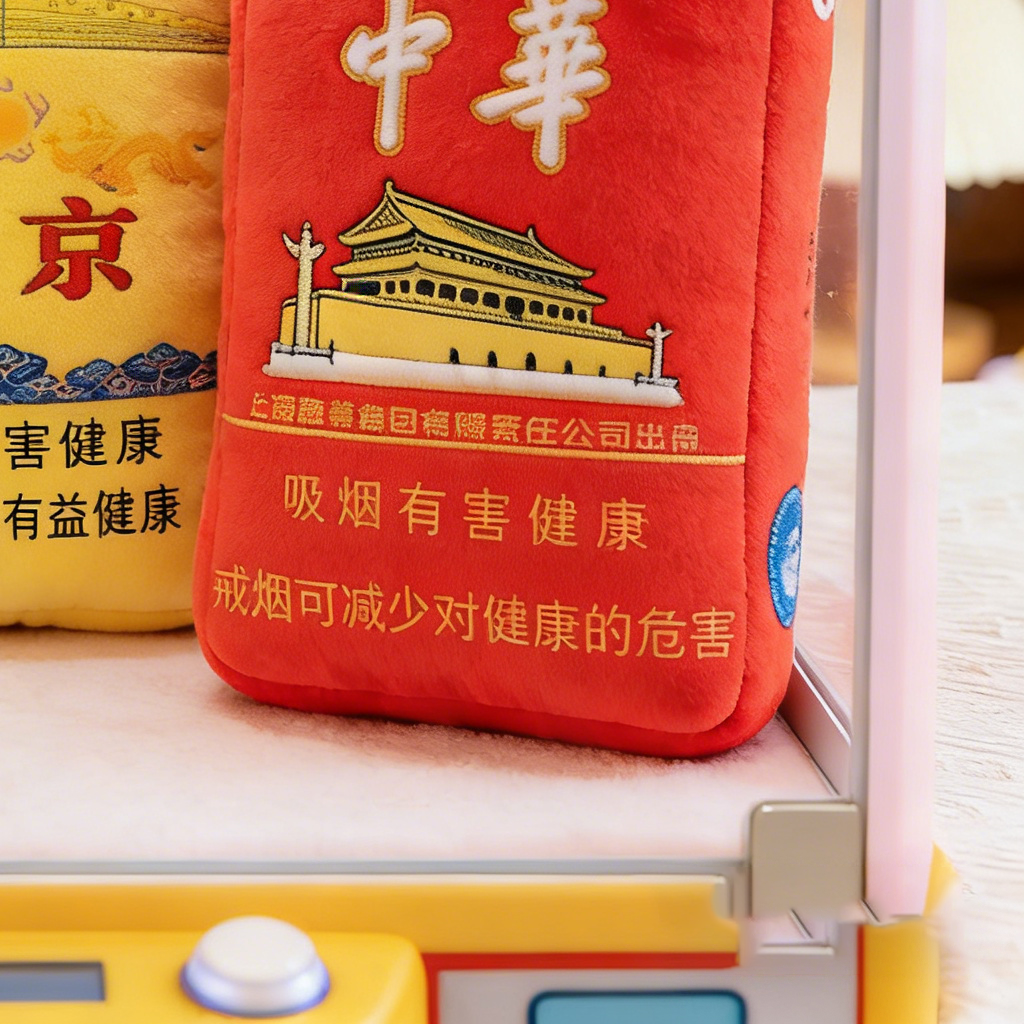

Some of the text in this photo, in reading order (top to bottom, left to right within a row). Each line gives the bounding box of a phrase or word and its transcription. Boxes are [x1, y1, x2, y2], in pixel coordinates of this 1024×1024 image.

[284, 474, 649, 551] 吸烟有害健康
[213, 564, 738, 661] 戒烟可减少对健康的危害
